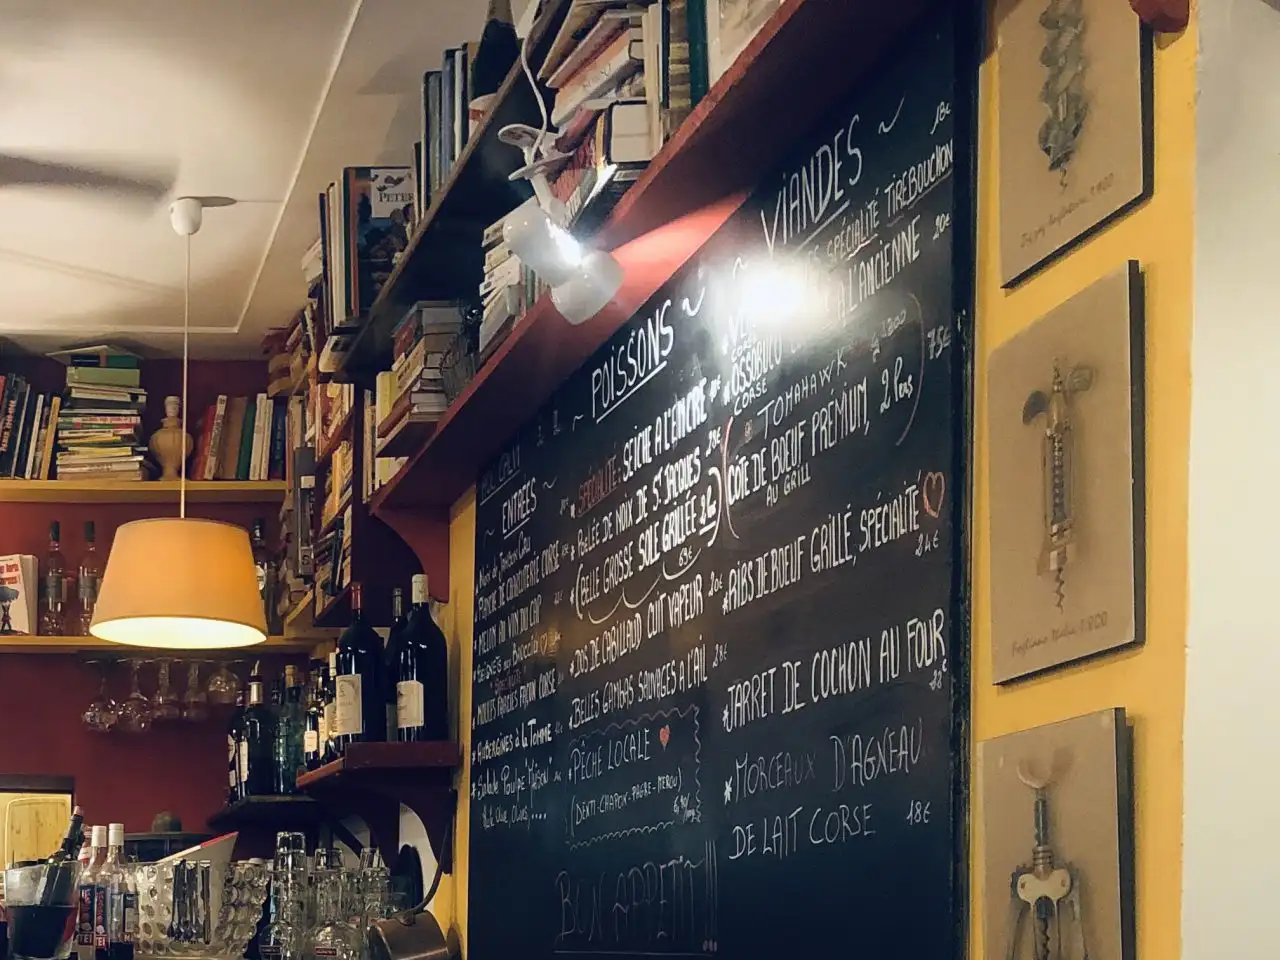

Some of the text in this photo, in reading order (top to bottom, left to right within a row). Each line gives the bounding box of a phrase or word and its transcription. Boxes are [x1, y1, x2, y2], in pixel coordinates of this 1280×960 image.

[760, 114, 863, 260] VIANDES
[884, 138, 954, 218] TIREBOUCHON
[848, 214, 921, 313] L'ANCIENNE
[592, 299, 674, 418] POISSONS
[731, 332, 783, 396] OSSOBUCO
[757, 350, 848, 440] TOMAHAWK
[622, 425, 653, 482] SEICHE
[655, 416, 663, 457] A
[751, 448, 768, 493] DE
[771, 420, 807, 482] BOEUF
[765, 461, 812, 508] AU GRILL
[602, 511, 614, 543] DE
[636, 485, 649, 525] DE
[664, 446, 701, 505] JACQUES
[603, 541, 634, 594] GROSSE
[638, 521, 660, 572] SOLE
[727, 560, 755, 612] RIBS
[755, 552, 769, 599] DE
[770, 535, 806, 593] BOEUF
[589, 636, 601, 672] DE
[646, 591, 667, 639] CUIT
[667, 573, 704, 629] VAPEUR
[571, 689, 600, 729] BELLES
[679, 660, 685, 693] A
[727, 665, 777, 733] JARRET
[782, 660, 807, 715] DE
[811, 637, 871, 704] COCHON
[879, 624, 900, 684] AU
[906, 607, 946, 673] FOUR
[607, 727, 651, 771] LOCALE
[829, 716, 923, 793] D'AGNEAU
[728, 823, 757, 860] DE
[762, 806, 804, 859] LAIT
[809, 803, 877, 844] CORSE
